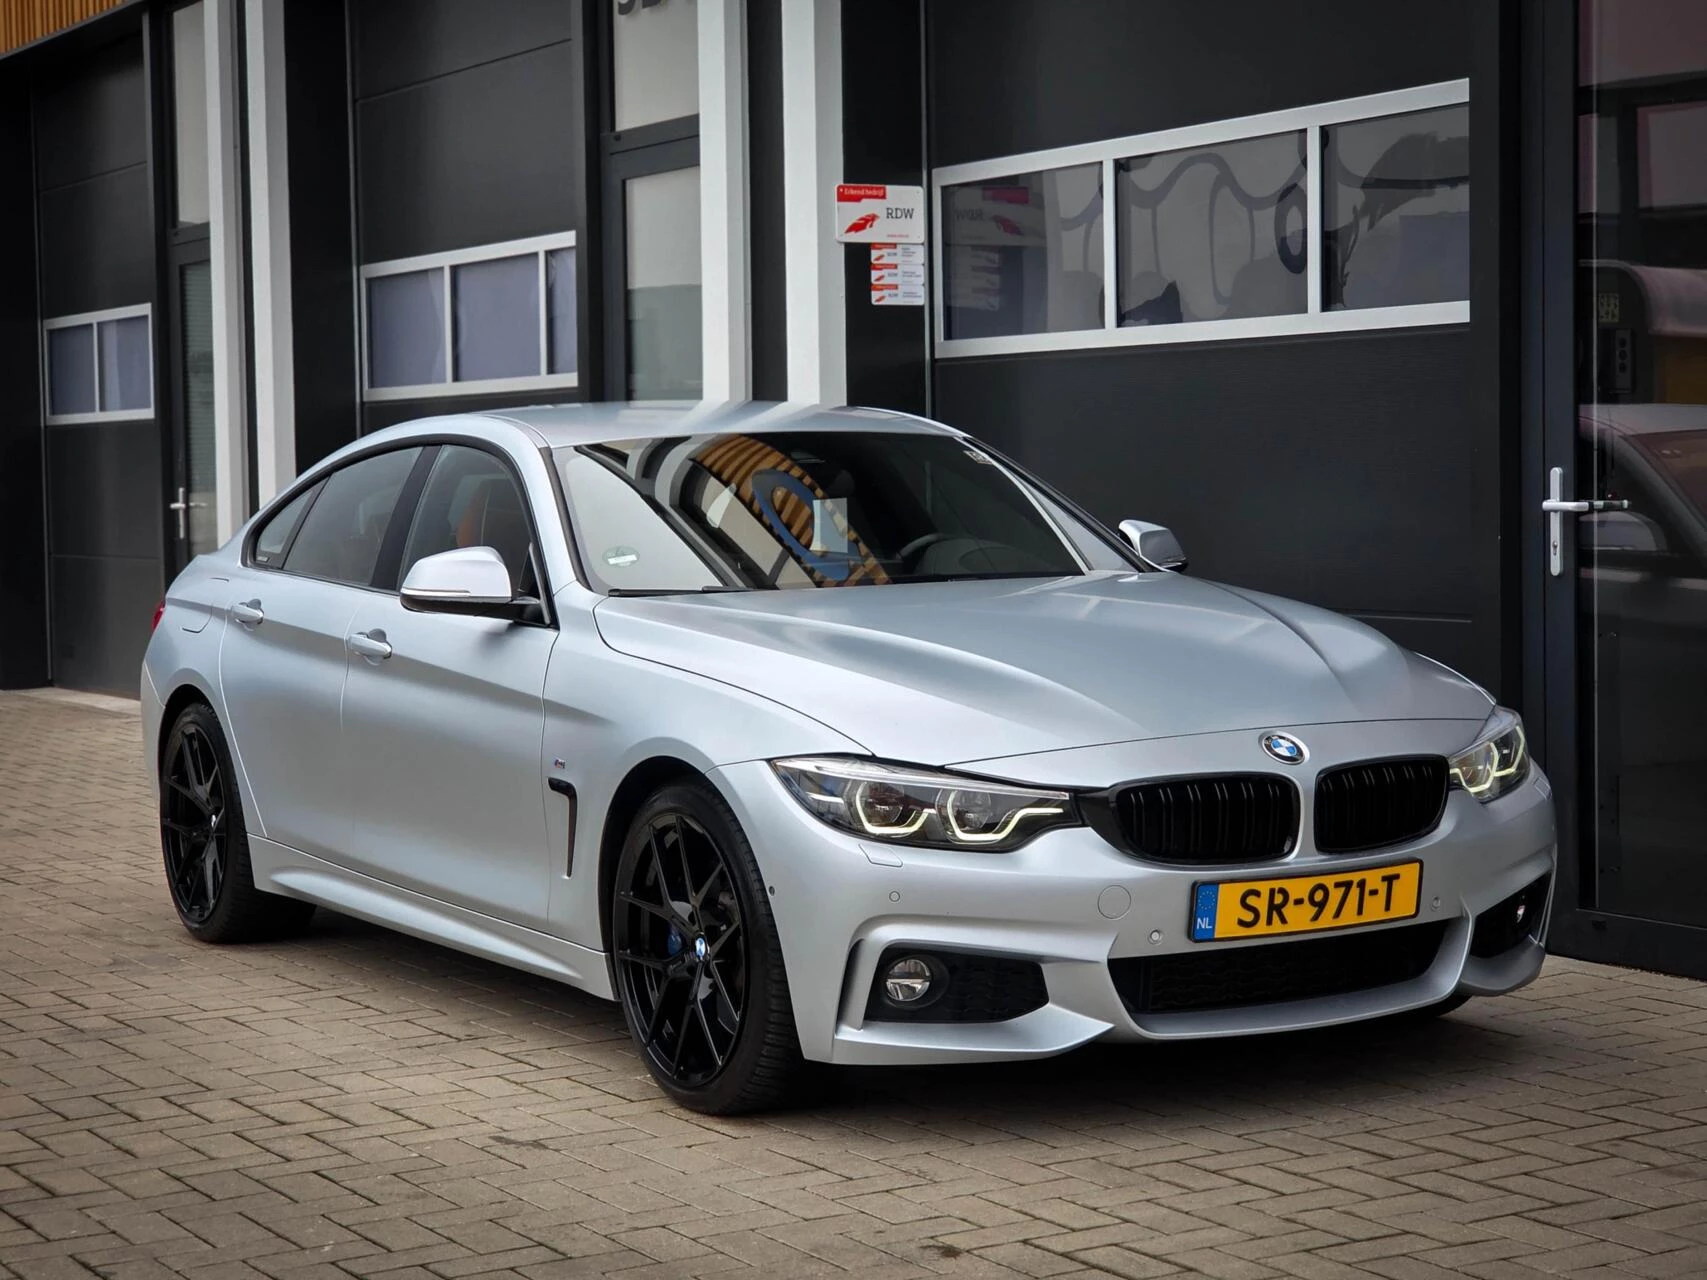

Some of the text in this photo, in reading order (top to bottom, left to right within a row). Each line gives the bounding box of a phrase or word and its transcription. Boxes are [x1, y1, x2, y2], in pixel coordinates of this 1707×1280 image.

[886, 207, 914, 219] RDW
[1236, 873, 1401, 929] SR-971-T
[1196, 917, 1213, 929] NL
